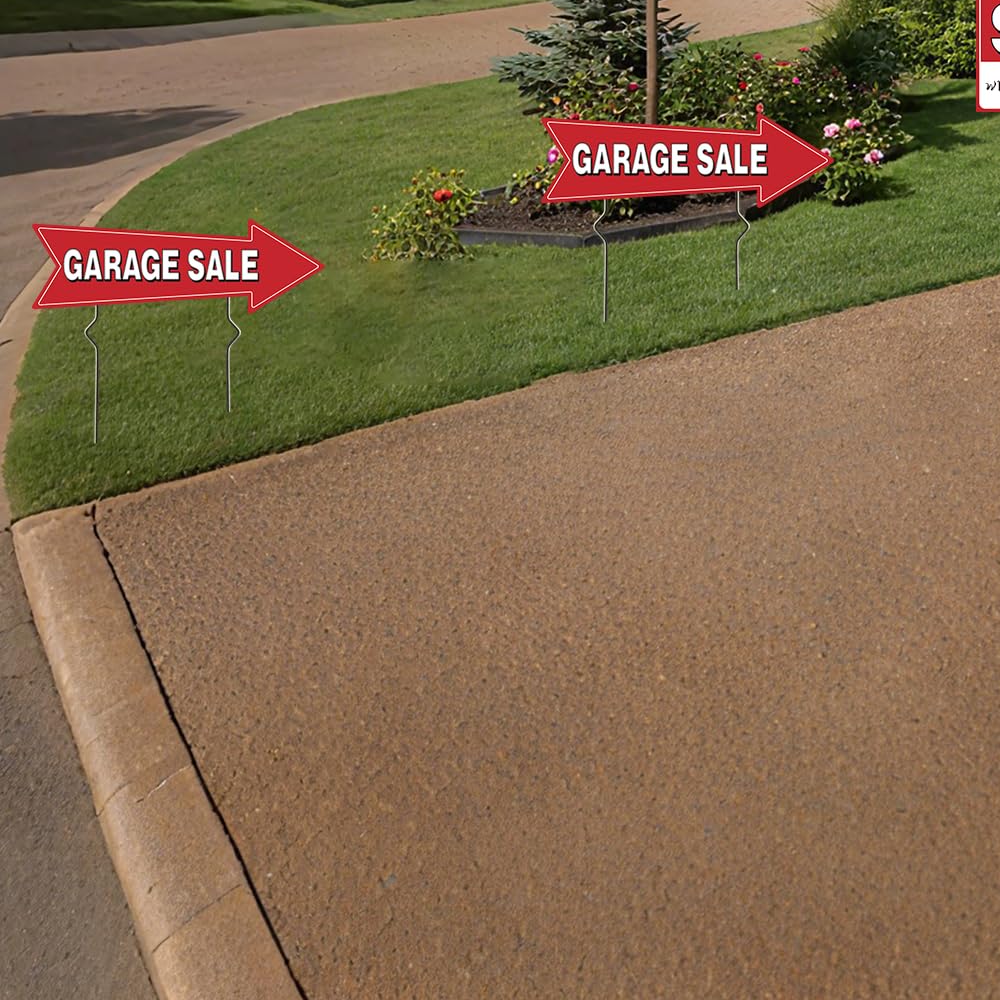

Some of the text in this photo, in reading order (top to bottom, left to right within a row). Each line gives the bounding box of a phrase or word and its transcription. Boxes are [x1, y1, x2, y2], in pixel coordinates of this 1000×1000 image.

[572, 142, 768, 176] GARAGE SALE
[63, 248, 260, 282] GARAGE SALE
